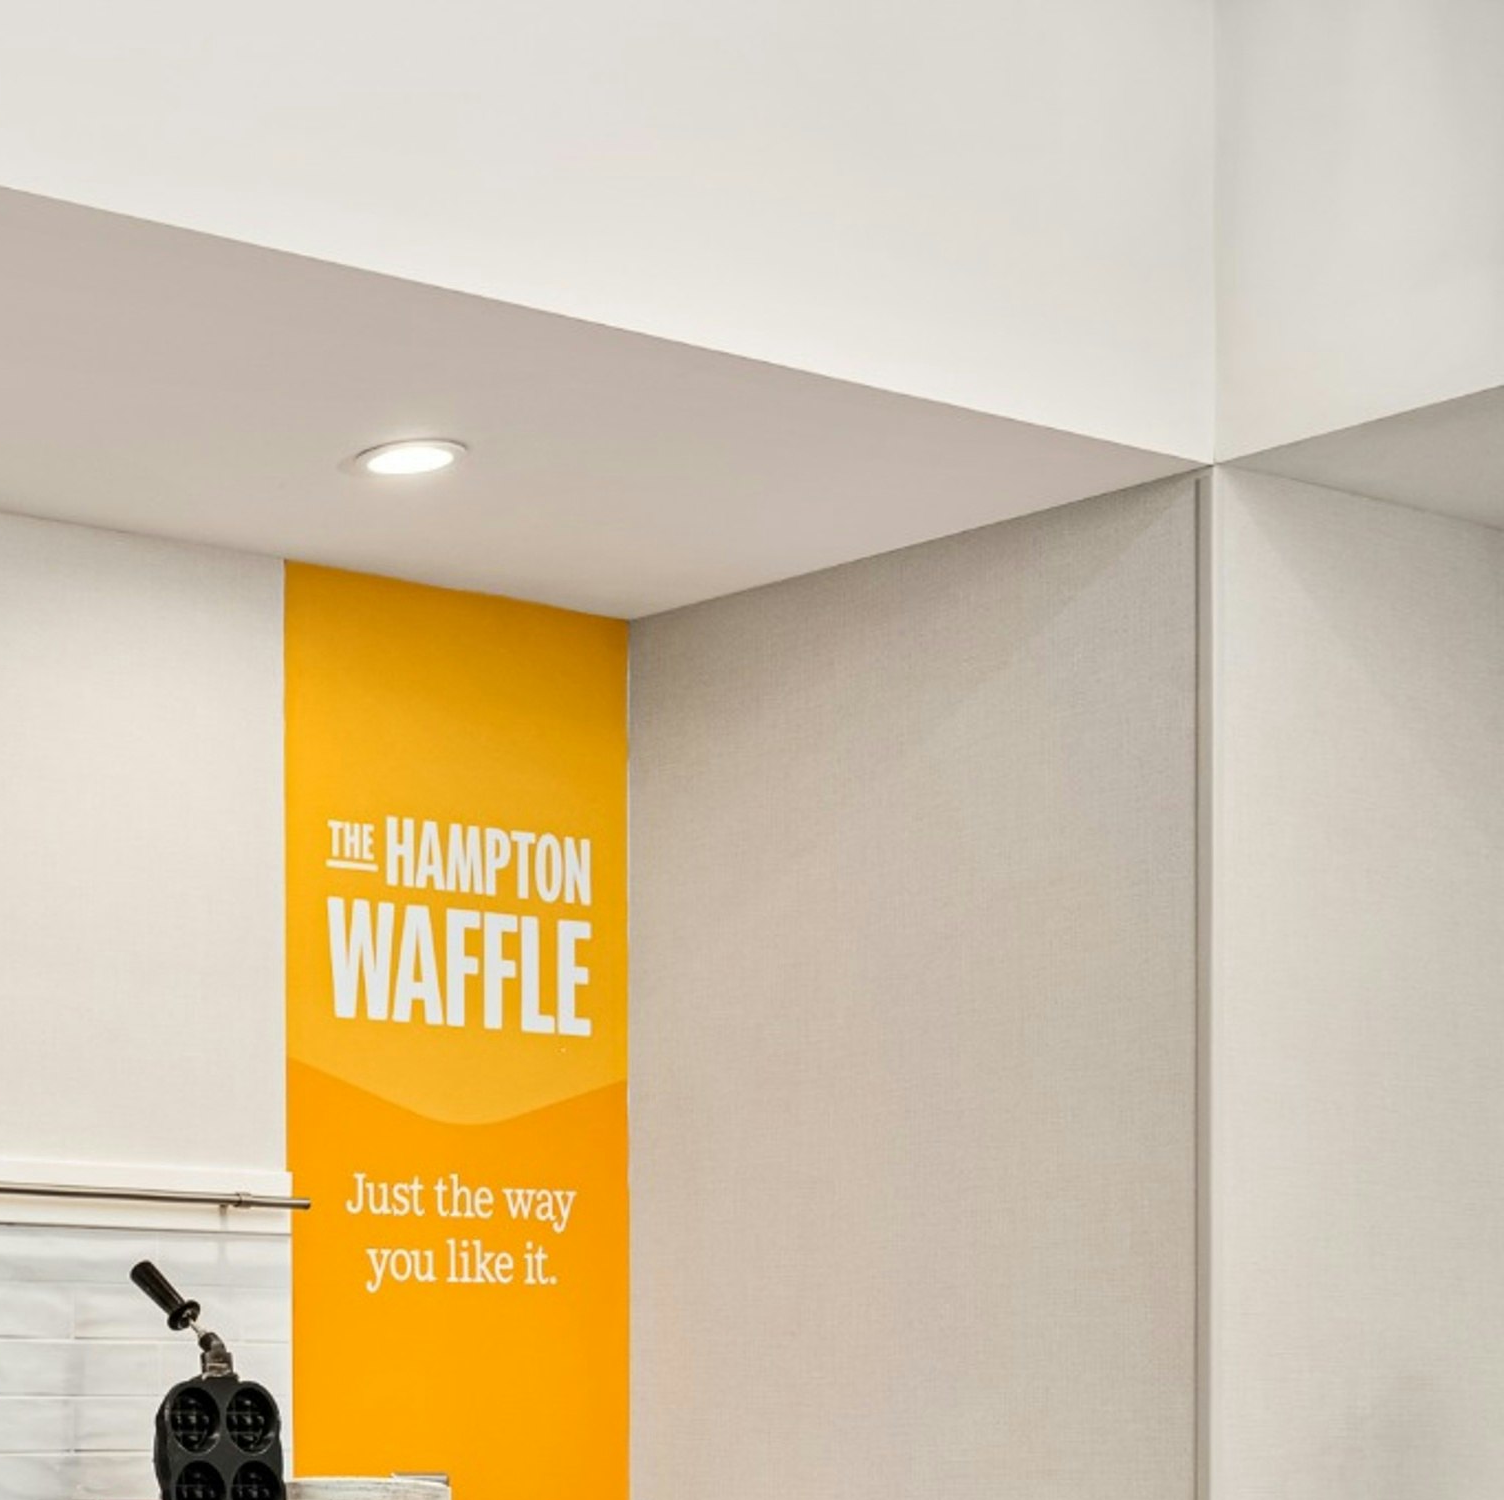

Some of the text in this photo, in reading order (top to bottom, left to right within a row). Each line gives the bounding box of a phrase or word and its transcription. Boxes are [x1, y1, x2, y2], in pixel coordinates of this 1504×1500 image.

[327, 815, 592, 906] THE HAMPTON
[326, 896, 592, 1037] WAFFLE
[346, 1173, 576, 1234] Just the way
[365, 1238, 558, 1293] you like it.
